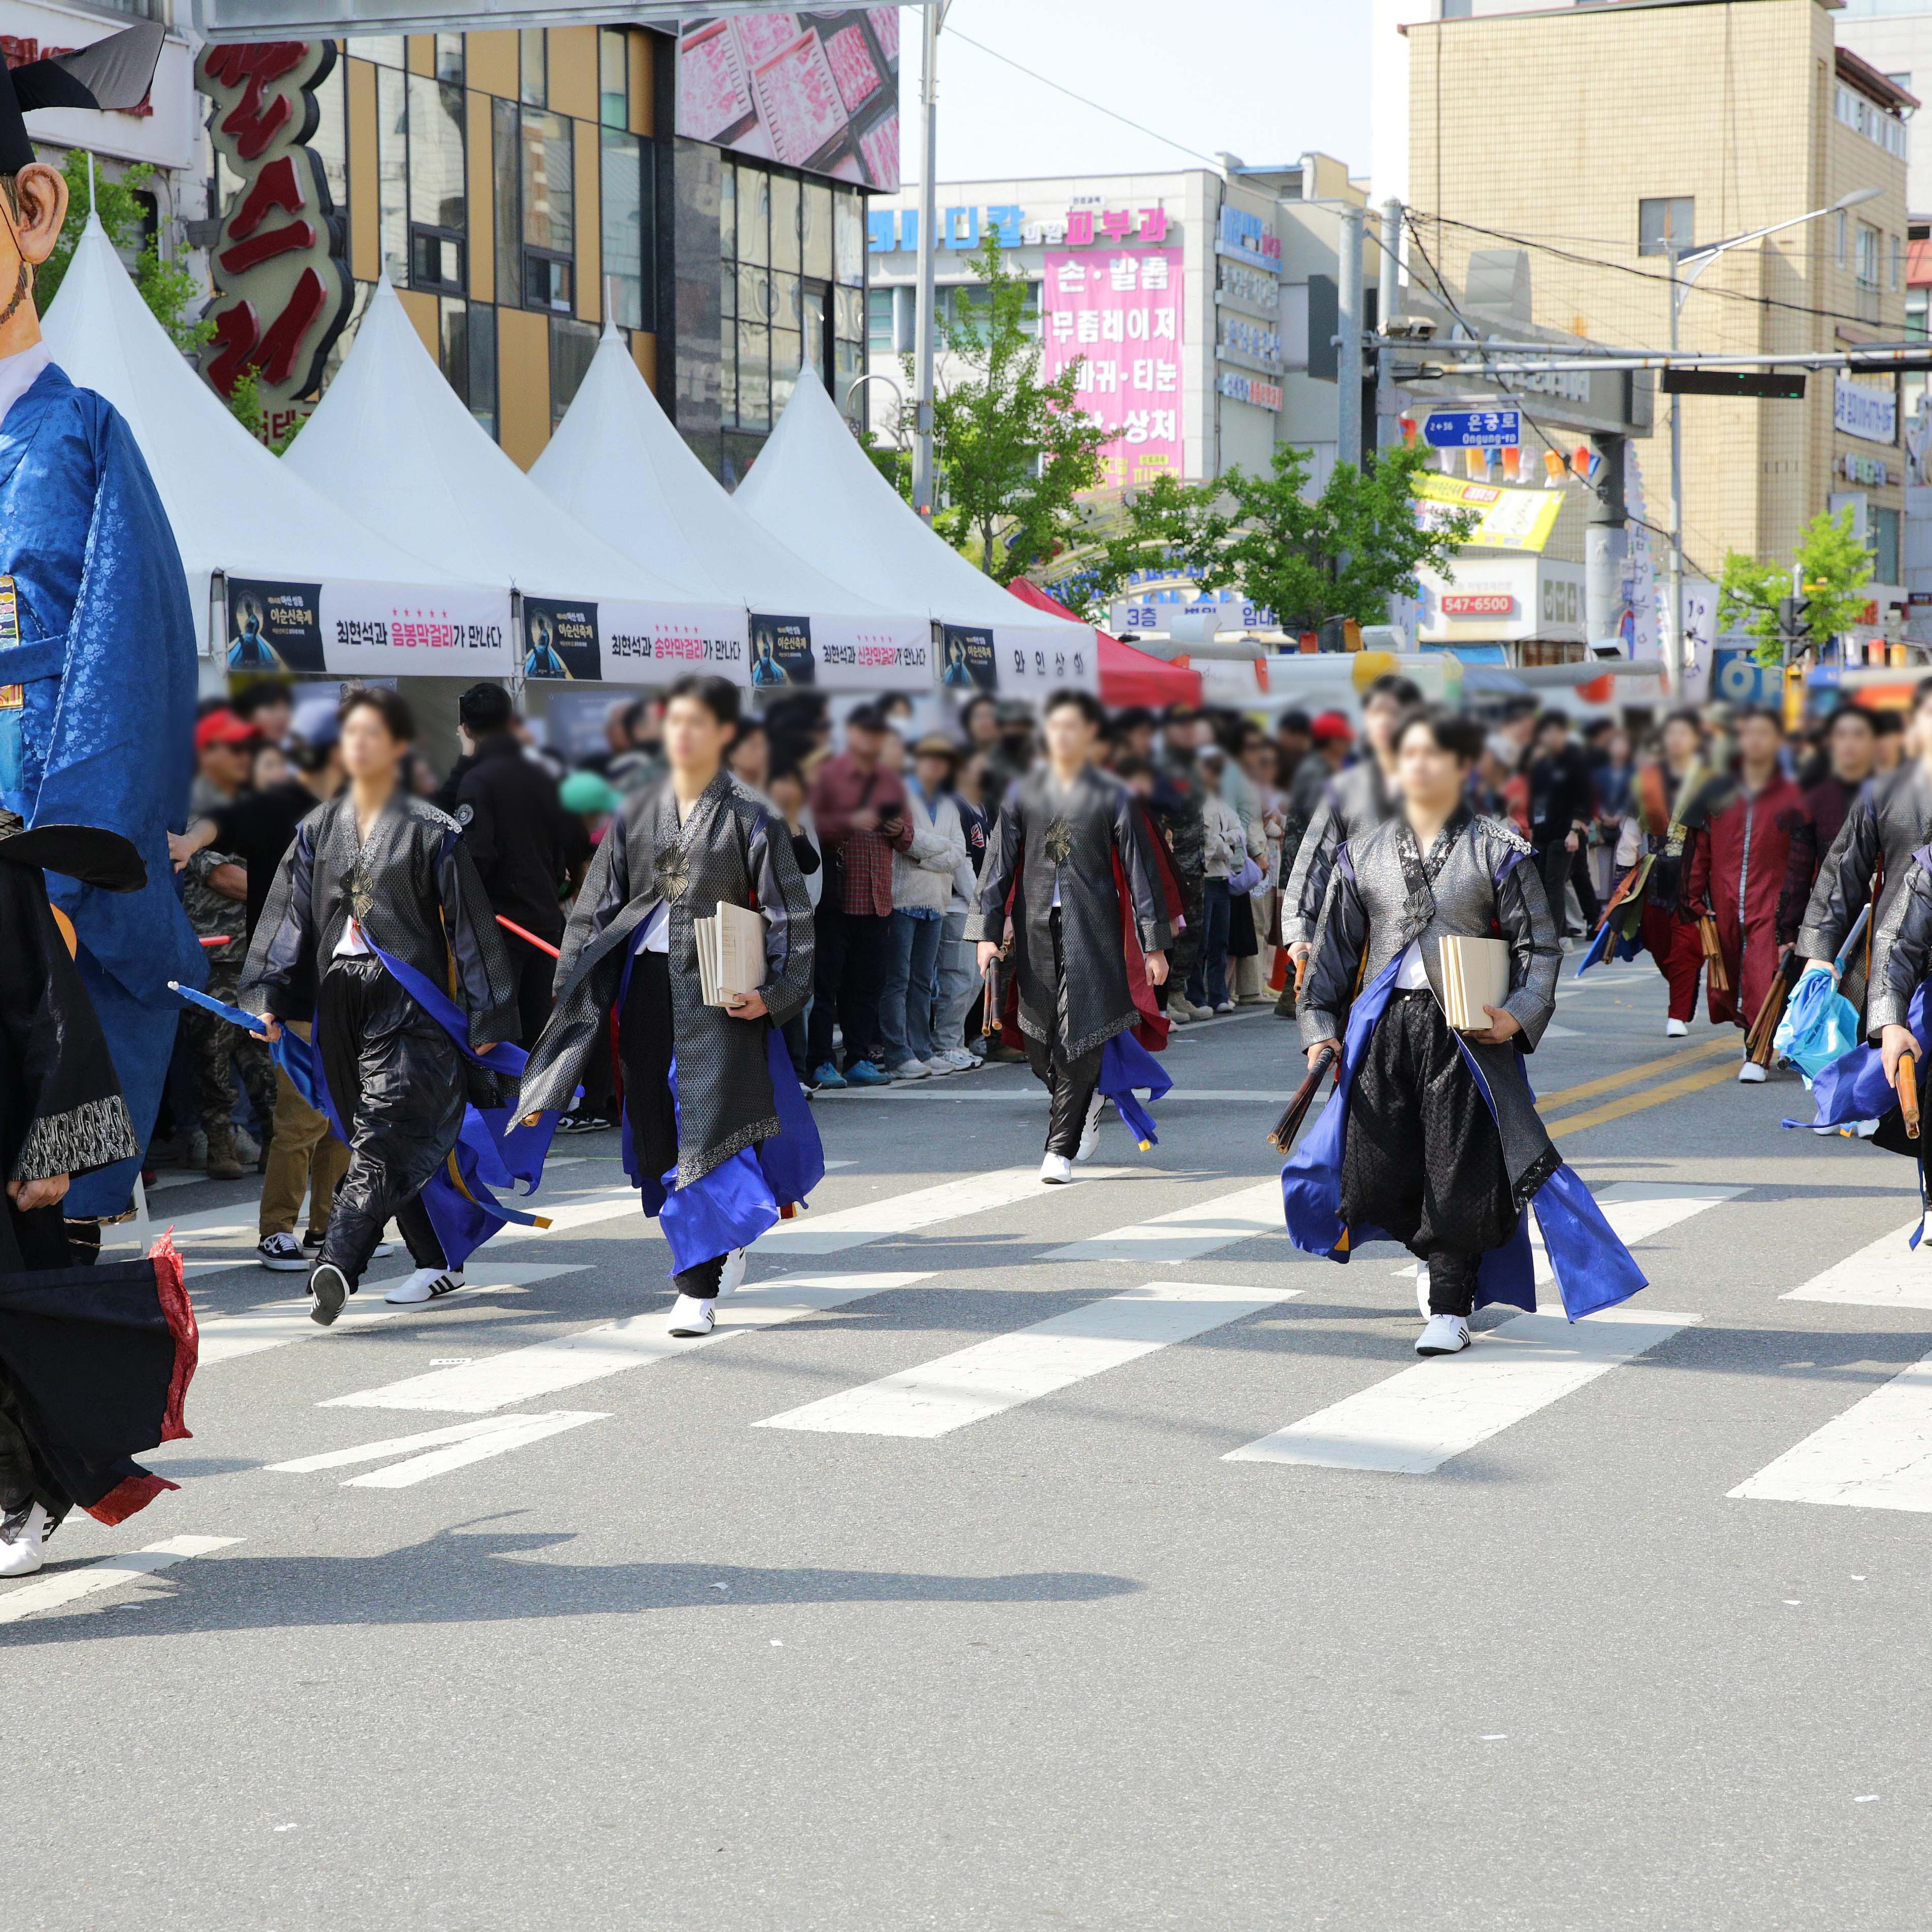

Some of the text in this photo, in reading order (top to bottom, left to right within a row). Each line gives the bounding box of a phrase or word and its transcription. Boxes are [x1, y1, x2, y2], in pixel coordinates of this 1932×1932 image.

[1065, 207, 1169, 245] 피부과
[1052, 307, 1176, 345] 무좀레이저
[1467, 413, 1516, 432] 온궁로
[1462, 433, 1516, 446] Ongung-ro
[1444, 598, 1509, 611] 547-6500
[270, 608, 312, 625] 이순신축제
[1128, 607, 1156, 626] 3층
[337, 620, 502, 649] 최현석과 음봉막걸리가 만나다
[558, 623, 593, 639] 이순신축제
[612, 634, 741, 661] 최현석과 송악막걸리가 만나다
[823, 643, 856, 665] 최현석과
[904, 648, 926, 666] 만나다
